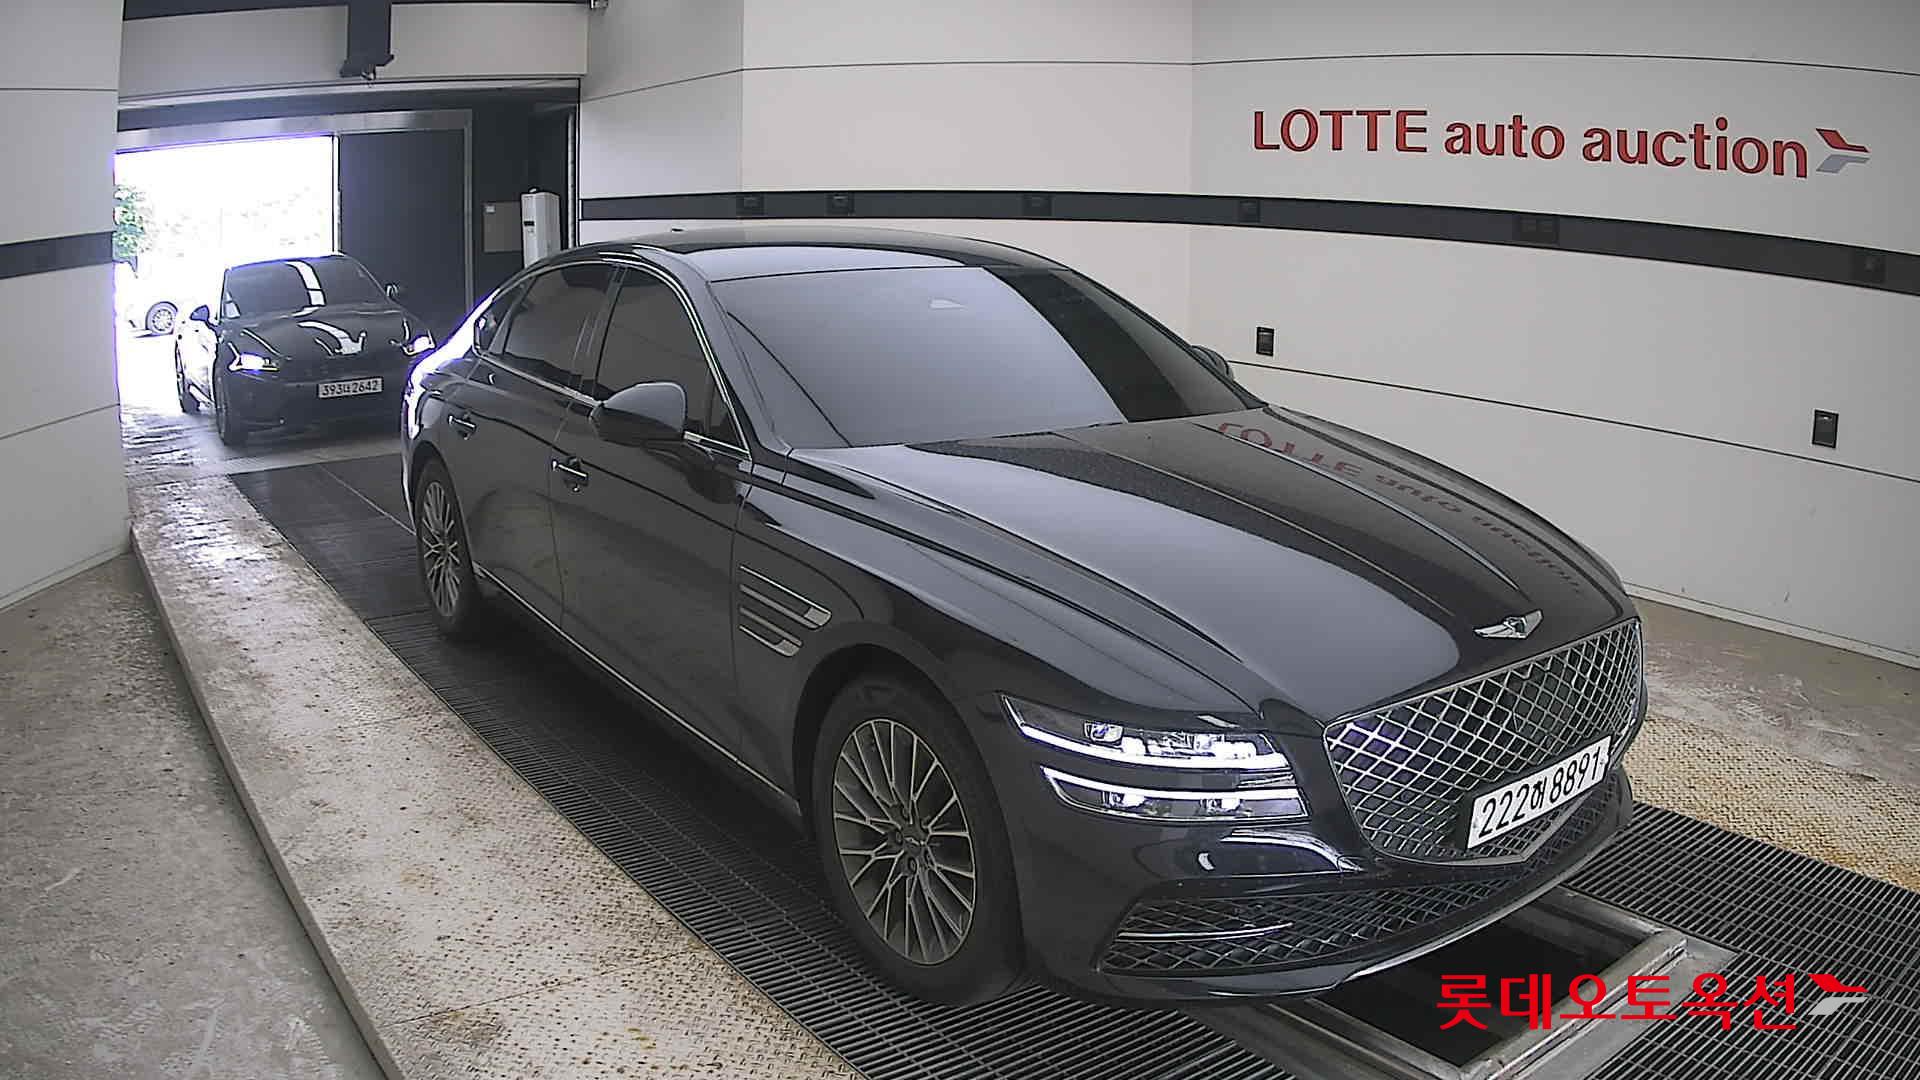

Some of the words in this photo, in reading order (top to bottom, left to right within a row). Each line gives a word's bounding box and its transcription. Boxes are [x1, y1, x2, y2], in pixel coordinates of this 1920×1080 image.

[1253, 109, 1428, 152] LOTTE
[1444, 115, 1565, 160] auto
[1582, 117, 1808, 178] auction
